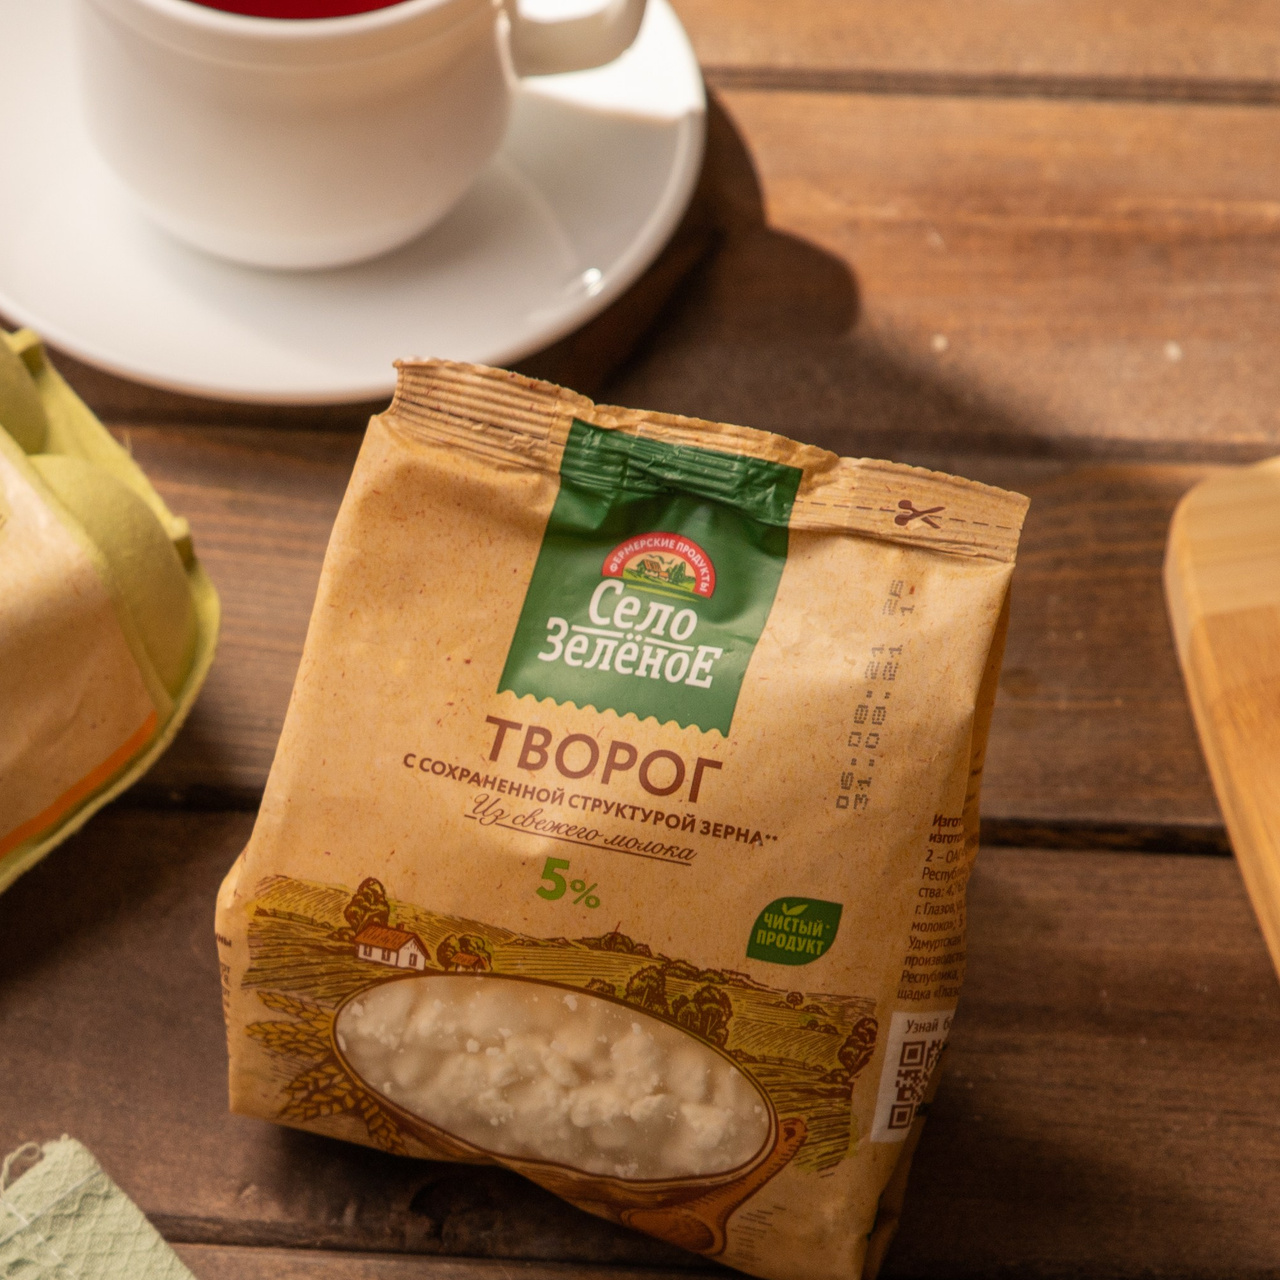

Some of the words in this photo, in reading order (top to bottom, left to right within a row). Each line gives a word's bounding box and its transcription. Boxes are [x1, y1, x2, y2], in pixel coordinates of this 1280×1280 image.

[609, 537, 676, 573] ФЕРМЕРСКИЕ
[675, 541, 712, 593] ПРОДУКТЫ
[588, 578, 698, 642] Село
[483, 714, 724, 804] ТВОРОГ
[402, 752, 417, 769] С
[418, 756, 565, 806] СОХРАНЕННОЙ
[567, 793, 697, 834] СТРУКТУРОЙ
[471, 793, 511, 826] Из
[511, 807, 605, 842] свежего
[603, 833, 698, 861] молока
[535, 855, 601, 910] 5%
[755, 929, 825, 956] ПРОДУКТ
[905, 1017, 939, 1034] Узнай
